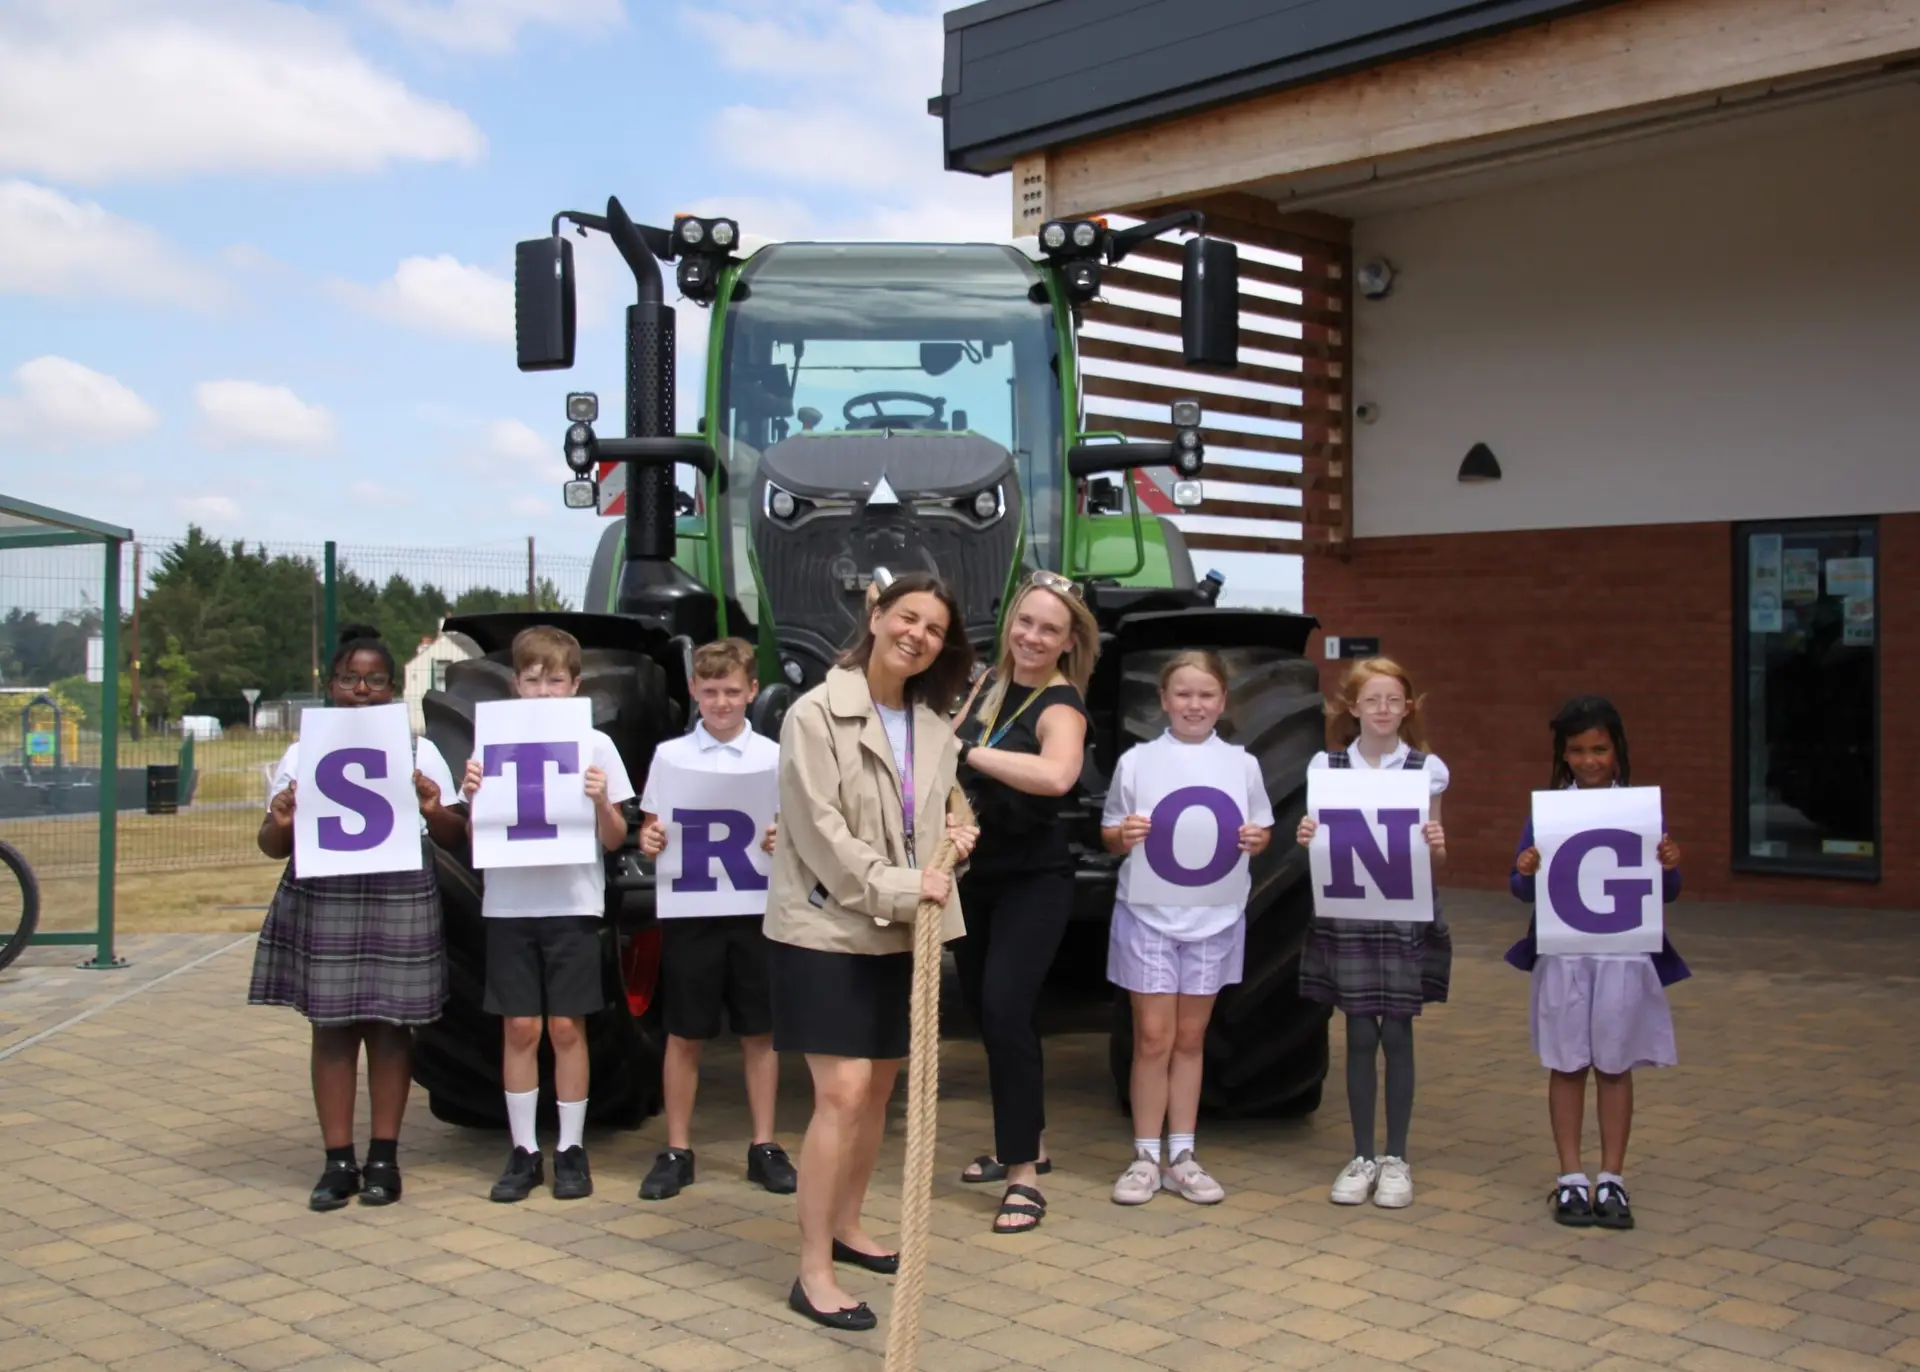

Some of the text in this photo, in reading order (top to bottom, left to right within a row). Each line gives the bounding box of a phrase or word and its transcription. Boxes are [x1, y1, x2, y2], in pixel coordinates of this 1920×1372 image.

[315, 748, 394, 852] S
[483, 741, 579, 841] T
[1144, 786, 1245, 887] O
[672, 808, 769, 892] R
[1318, 808, 1420, 900] N
[1548, 828, 1653, 934] G
